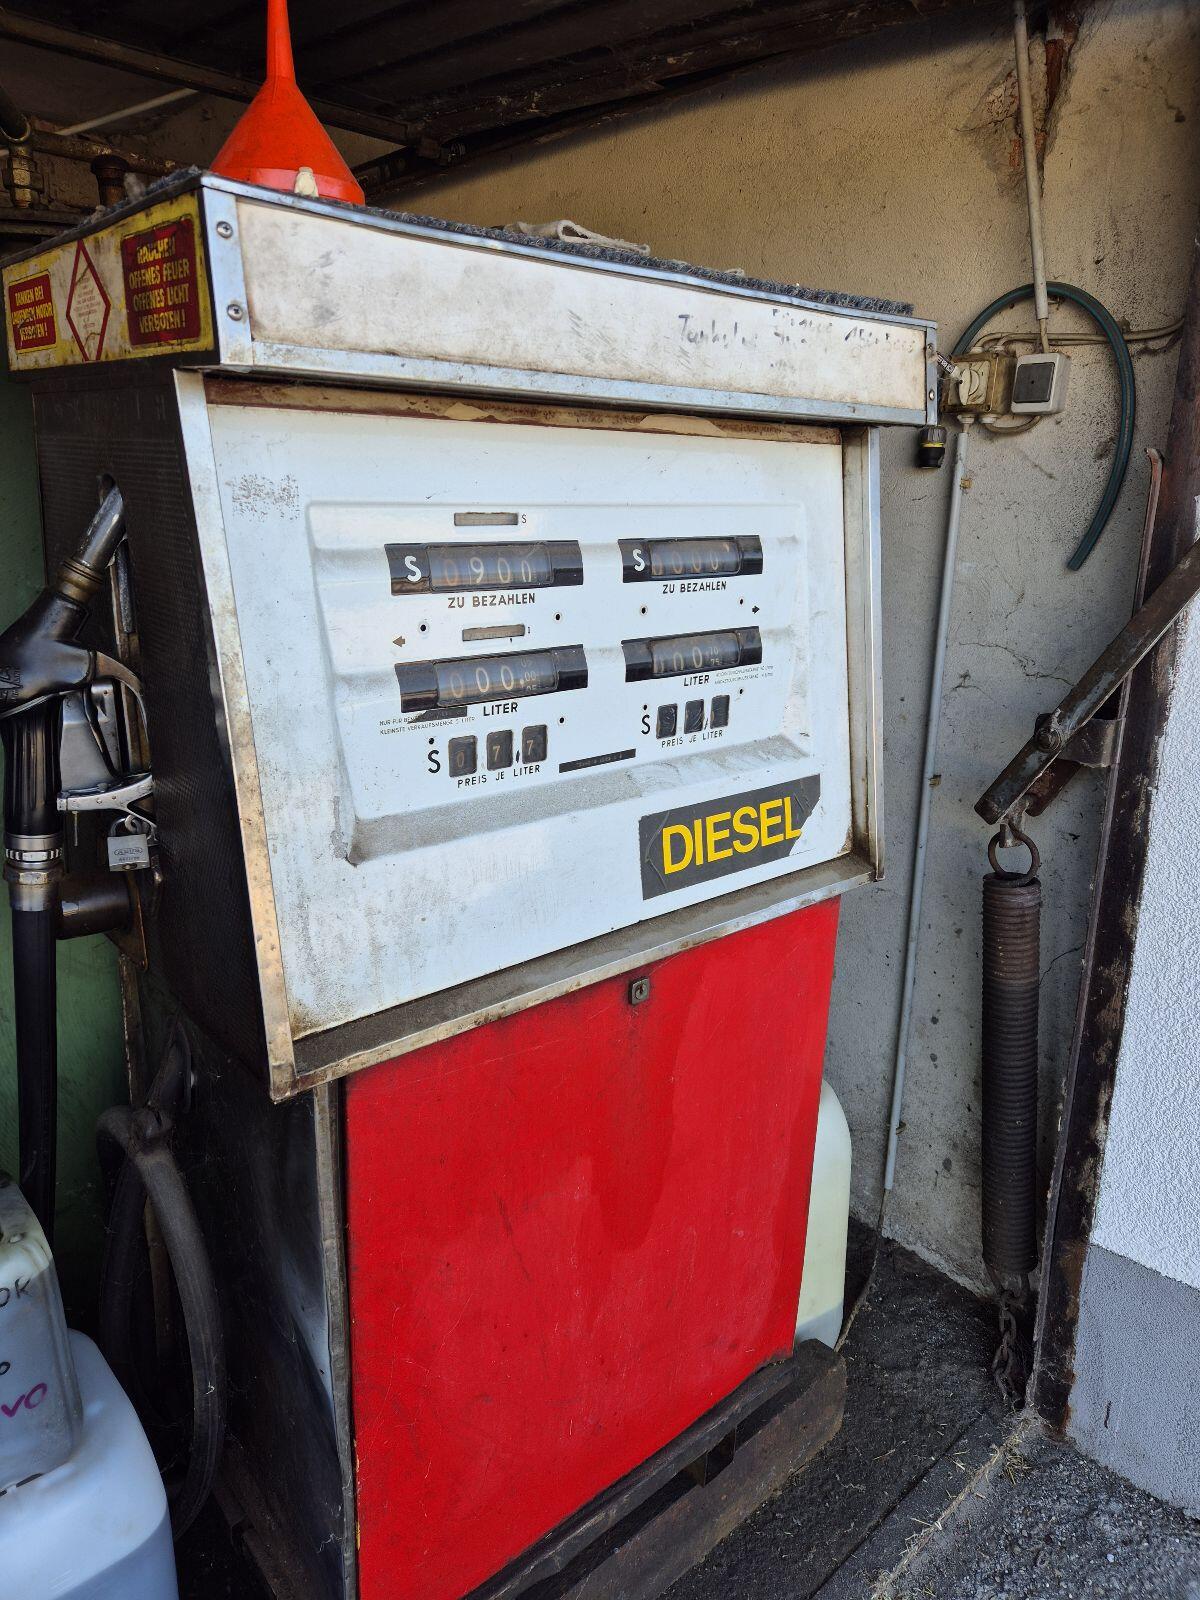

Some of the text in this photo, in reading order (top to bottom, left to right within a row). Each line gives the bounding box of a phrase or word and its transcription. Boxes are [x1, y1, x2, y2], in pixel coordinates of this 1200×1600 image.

[128, 258, 190, 290] OFFENES FEUER
[133, 283, 189, 311] OFFENES LICHT
[521, 513, 527, 524] S
[404, 555, 422, 582] S
[632, 548, 646, 572] S
[662, 580, 728, 594] ZU BEZAHLEN
[447, 592, 536, 609] ZU BEZAHLEN
[683, 674, 710, 687] LITER
[482, 701, 519, 717] LITER
[640, 714, 651, 735] S
[661, 729, 723, 748] PREIS JE LITER
[427, 749, 441, 774] S
[457, 764, 541, 789] PREIS JE LITER
[662, 796, 803, 875] DIESEL
